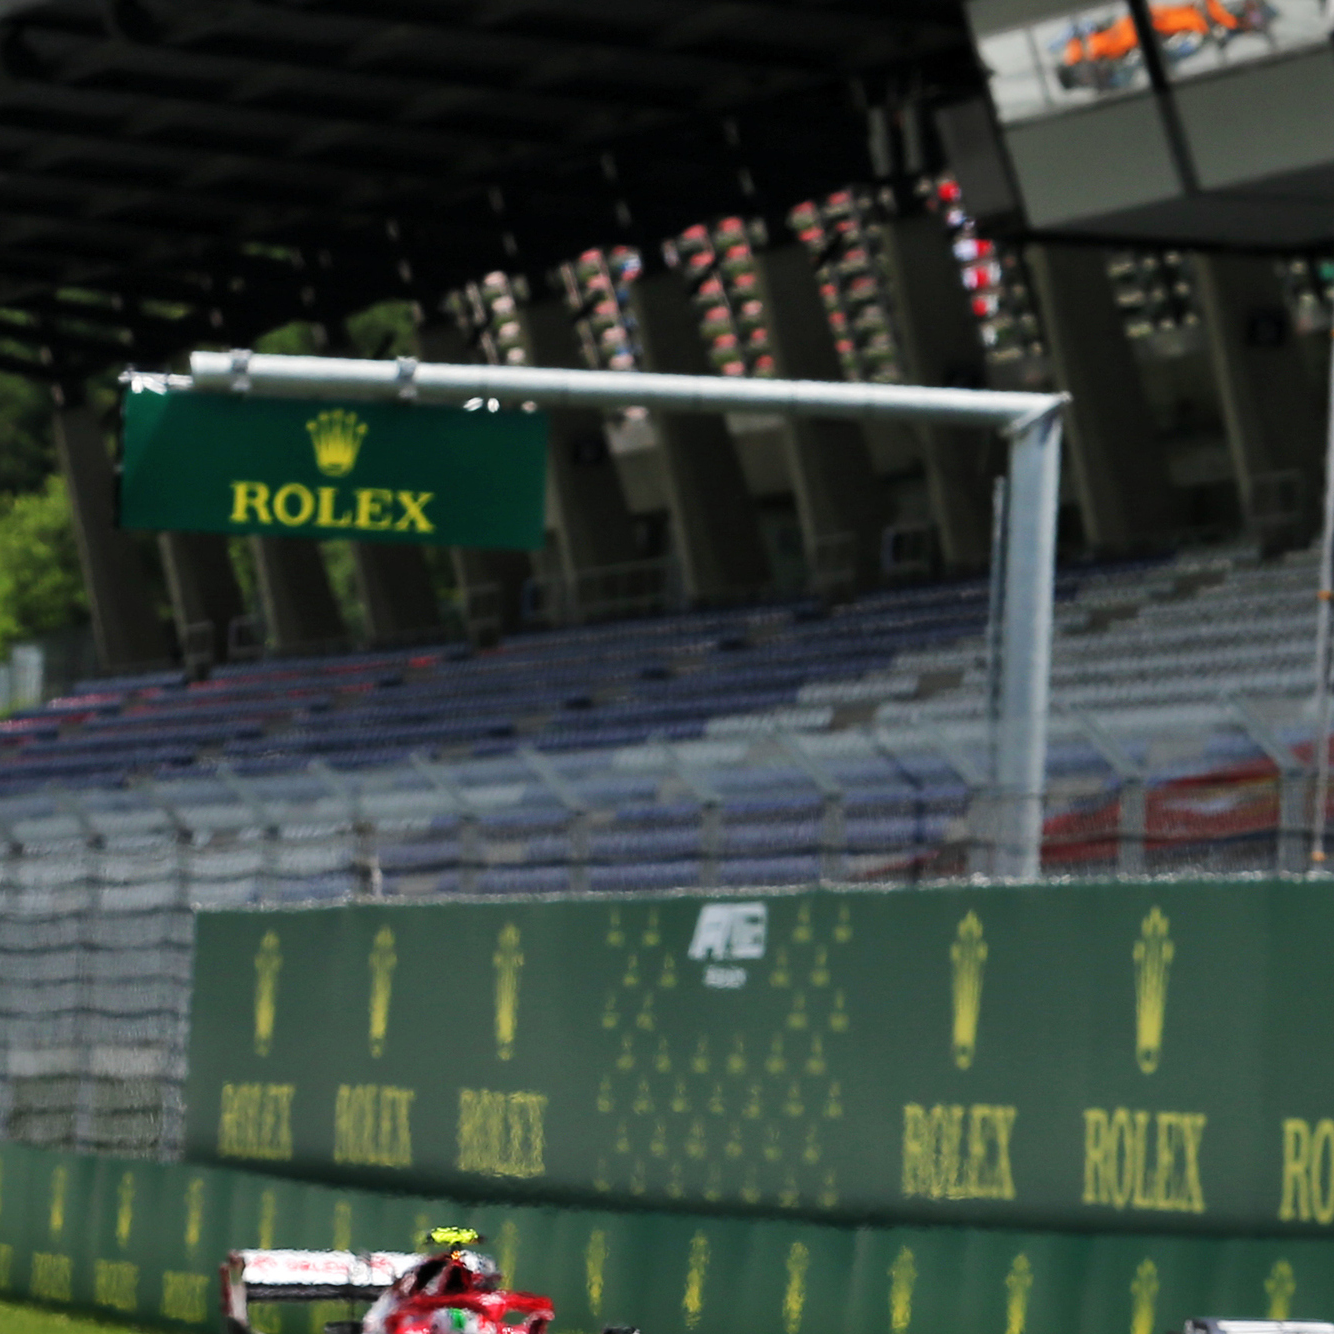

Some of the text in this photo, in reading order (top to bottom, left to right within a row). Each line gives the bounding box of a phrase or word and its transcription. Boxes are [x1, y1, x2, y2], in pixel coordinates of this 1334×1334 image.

[229, 480, 435, 533] ROLEX
[901, 1105, 1016, 1200] ROLEX
[1082, 1109, 1205, 1212] ROLEX
